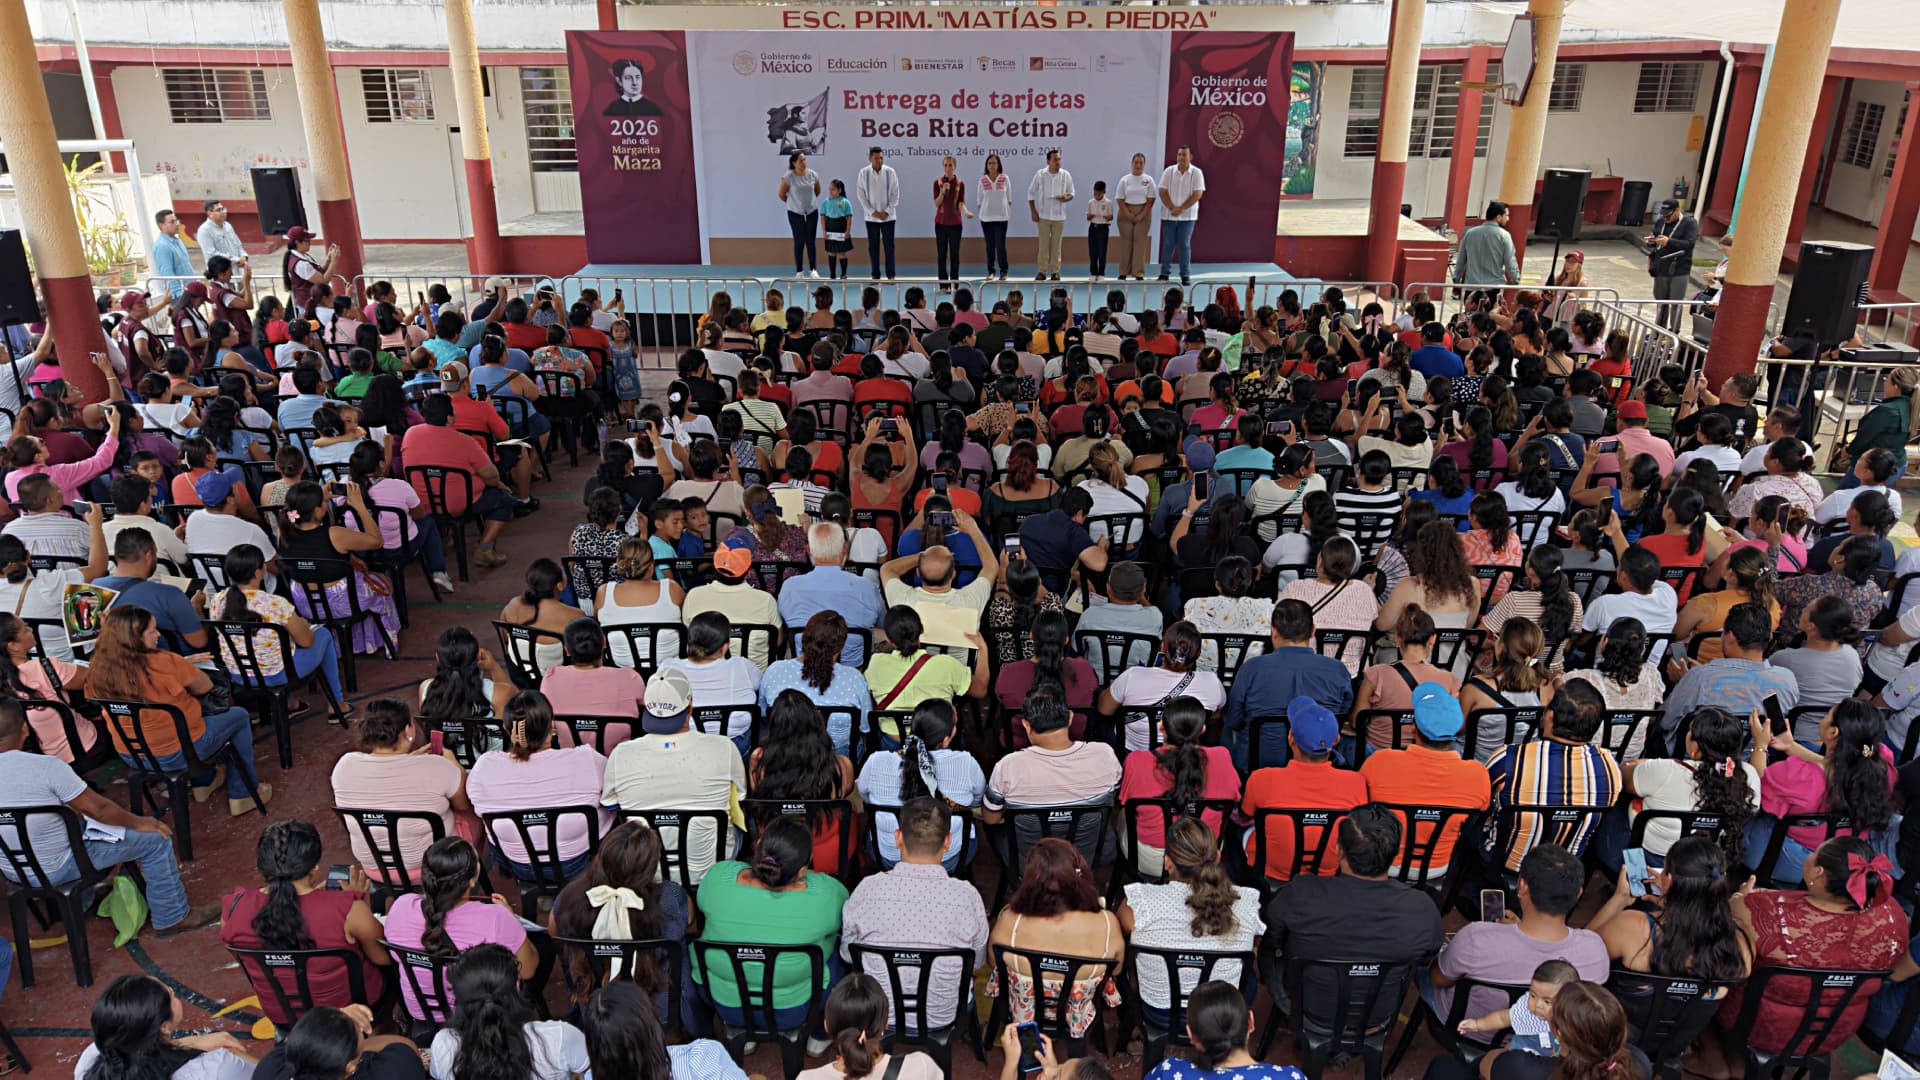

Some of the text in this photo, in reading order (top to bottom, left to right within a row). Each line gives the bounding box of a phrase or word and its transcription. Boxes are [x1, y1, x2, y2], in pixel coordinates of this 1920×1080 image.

[783, 7, 1217, 29] ESC. PRIM. "MATÍAS P. PIEDRA"
[760, 52, 812, 61] Gobierno de
[761, 60, 813, 73] México
[827, 57, 888, 70] Educación
[1191, 75, 1268, 87] Gobierno de
[843, 88, 1086, 115] Entrega de tarjetas
[1190, 87, 1266, 106] México
[610, 119, 659, 136] 2026
[860, 117, 1069, 138] Beca Rita Cetina
[621, 137, 650, 145] año de
[612, 145, 661, 156] Margarita
[956, 146, 968, 156] 24
[971, 146, 985, 156] de
[988, 147, 1018, 158] mayo
[1021, 146, 1034, 156] de
[612, 155, 662, 170] Maza
